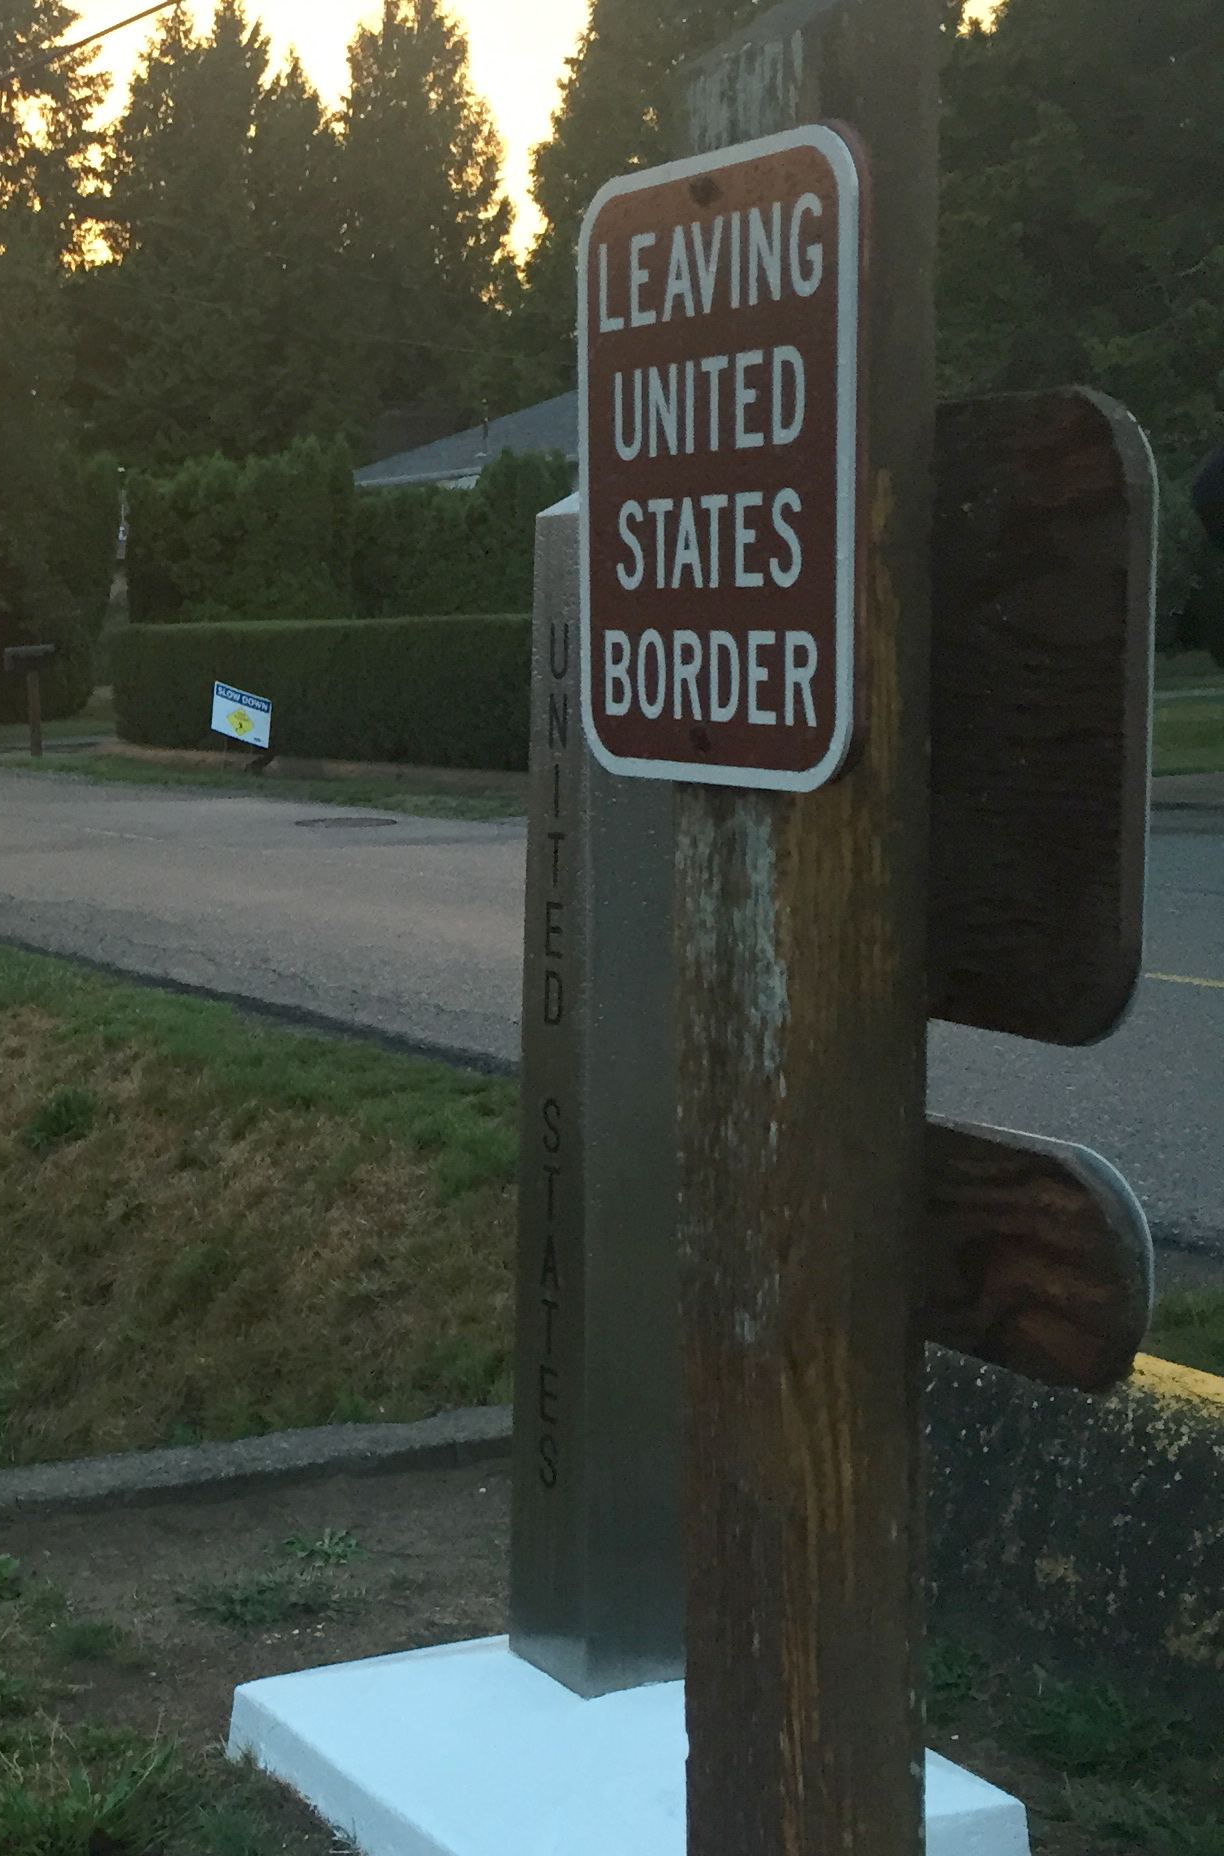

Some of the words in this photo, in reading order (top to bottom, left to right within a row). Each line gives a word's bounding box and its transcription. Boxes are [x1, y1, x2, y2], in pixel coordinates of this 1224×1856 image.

[597, 191, 824, 334] LEAVING
[613, 343, 807, 462] UNITED
[615, 486, 803, 591] STATES
[217, 686, 240, 701] SLOW
[241, 695, 269, 711] DOWN
[602, 627, 819, 728] BORDER
[543, 622, 570, 1027] UNITED
[538, 1097, 562, 1489] STATES
